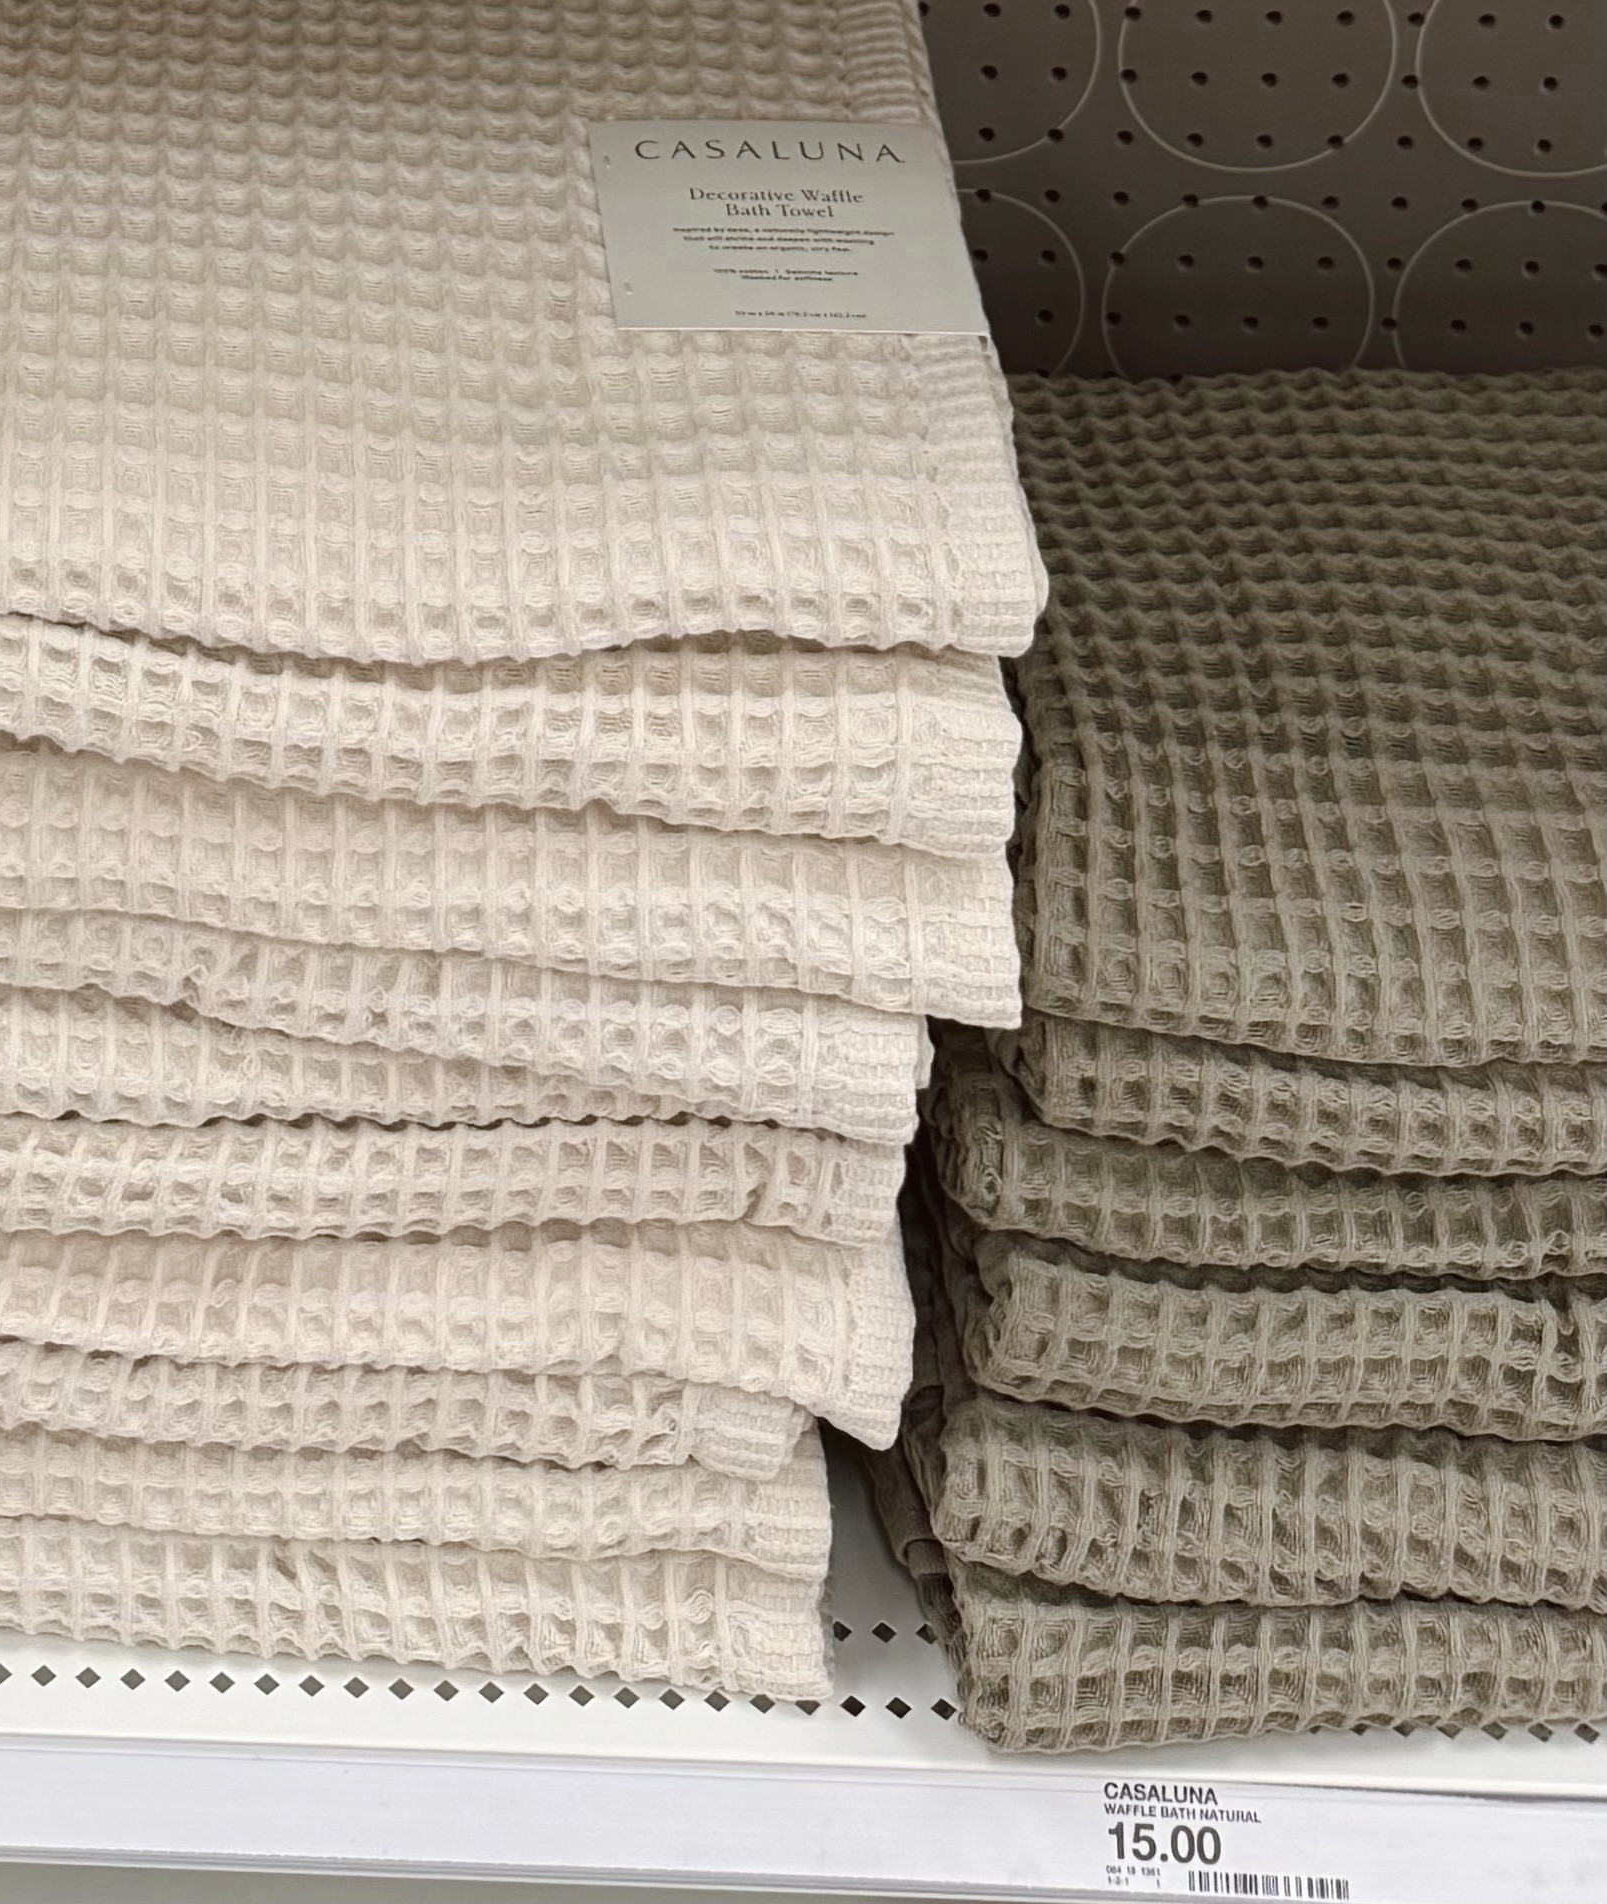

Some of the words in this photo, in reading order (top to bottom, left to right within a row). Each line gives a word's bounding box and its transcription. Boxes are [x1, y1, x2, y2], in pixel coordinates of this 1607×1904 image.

[634, 139, 903, 163] CASALUNA
[689, 187, 794, 202] Decorative
[800, 189, 864, 204] Waffle
[726, 203, 770, 217] Bath
[775, 203, 834, 218] Towel
[1103, 1782, 1218, 1806] CASALUNA
[1103, 1803, 1157, 1817] WAFFLE
[1160, 1806, 1196, 1820] BATH
[1199, 1808, 1262, 1823] NATURAL
[1108, 1821, 1222, 1865] 15.00
